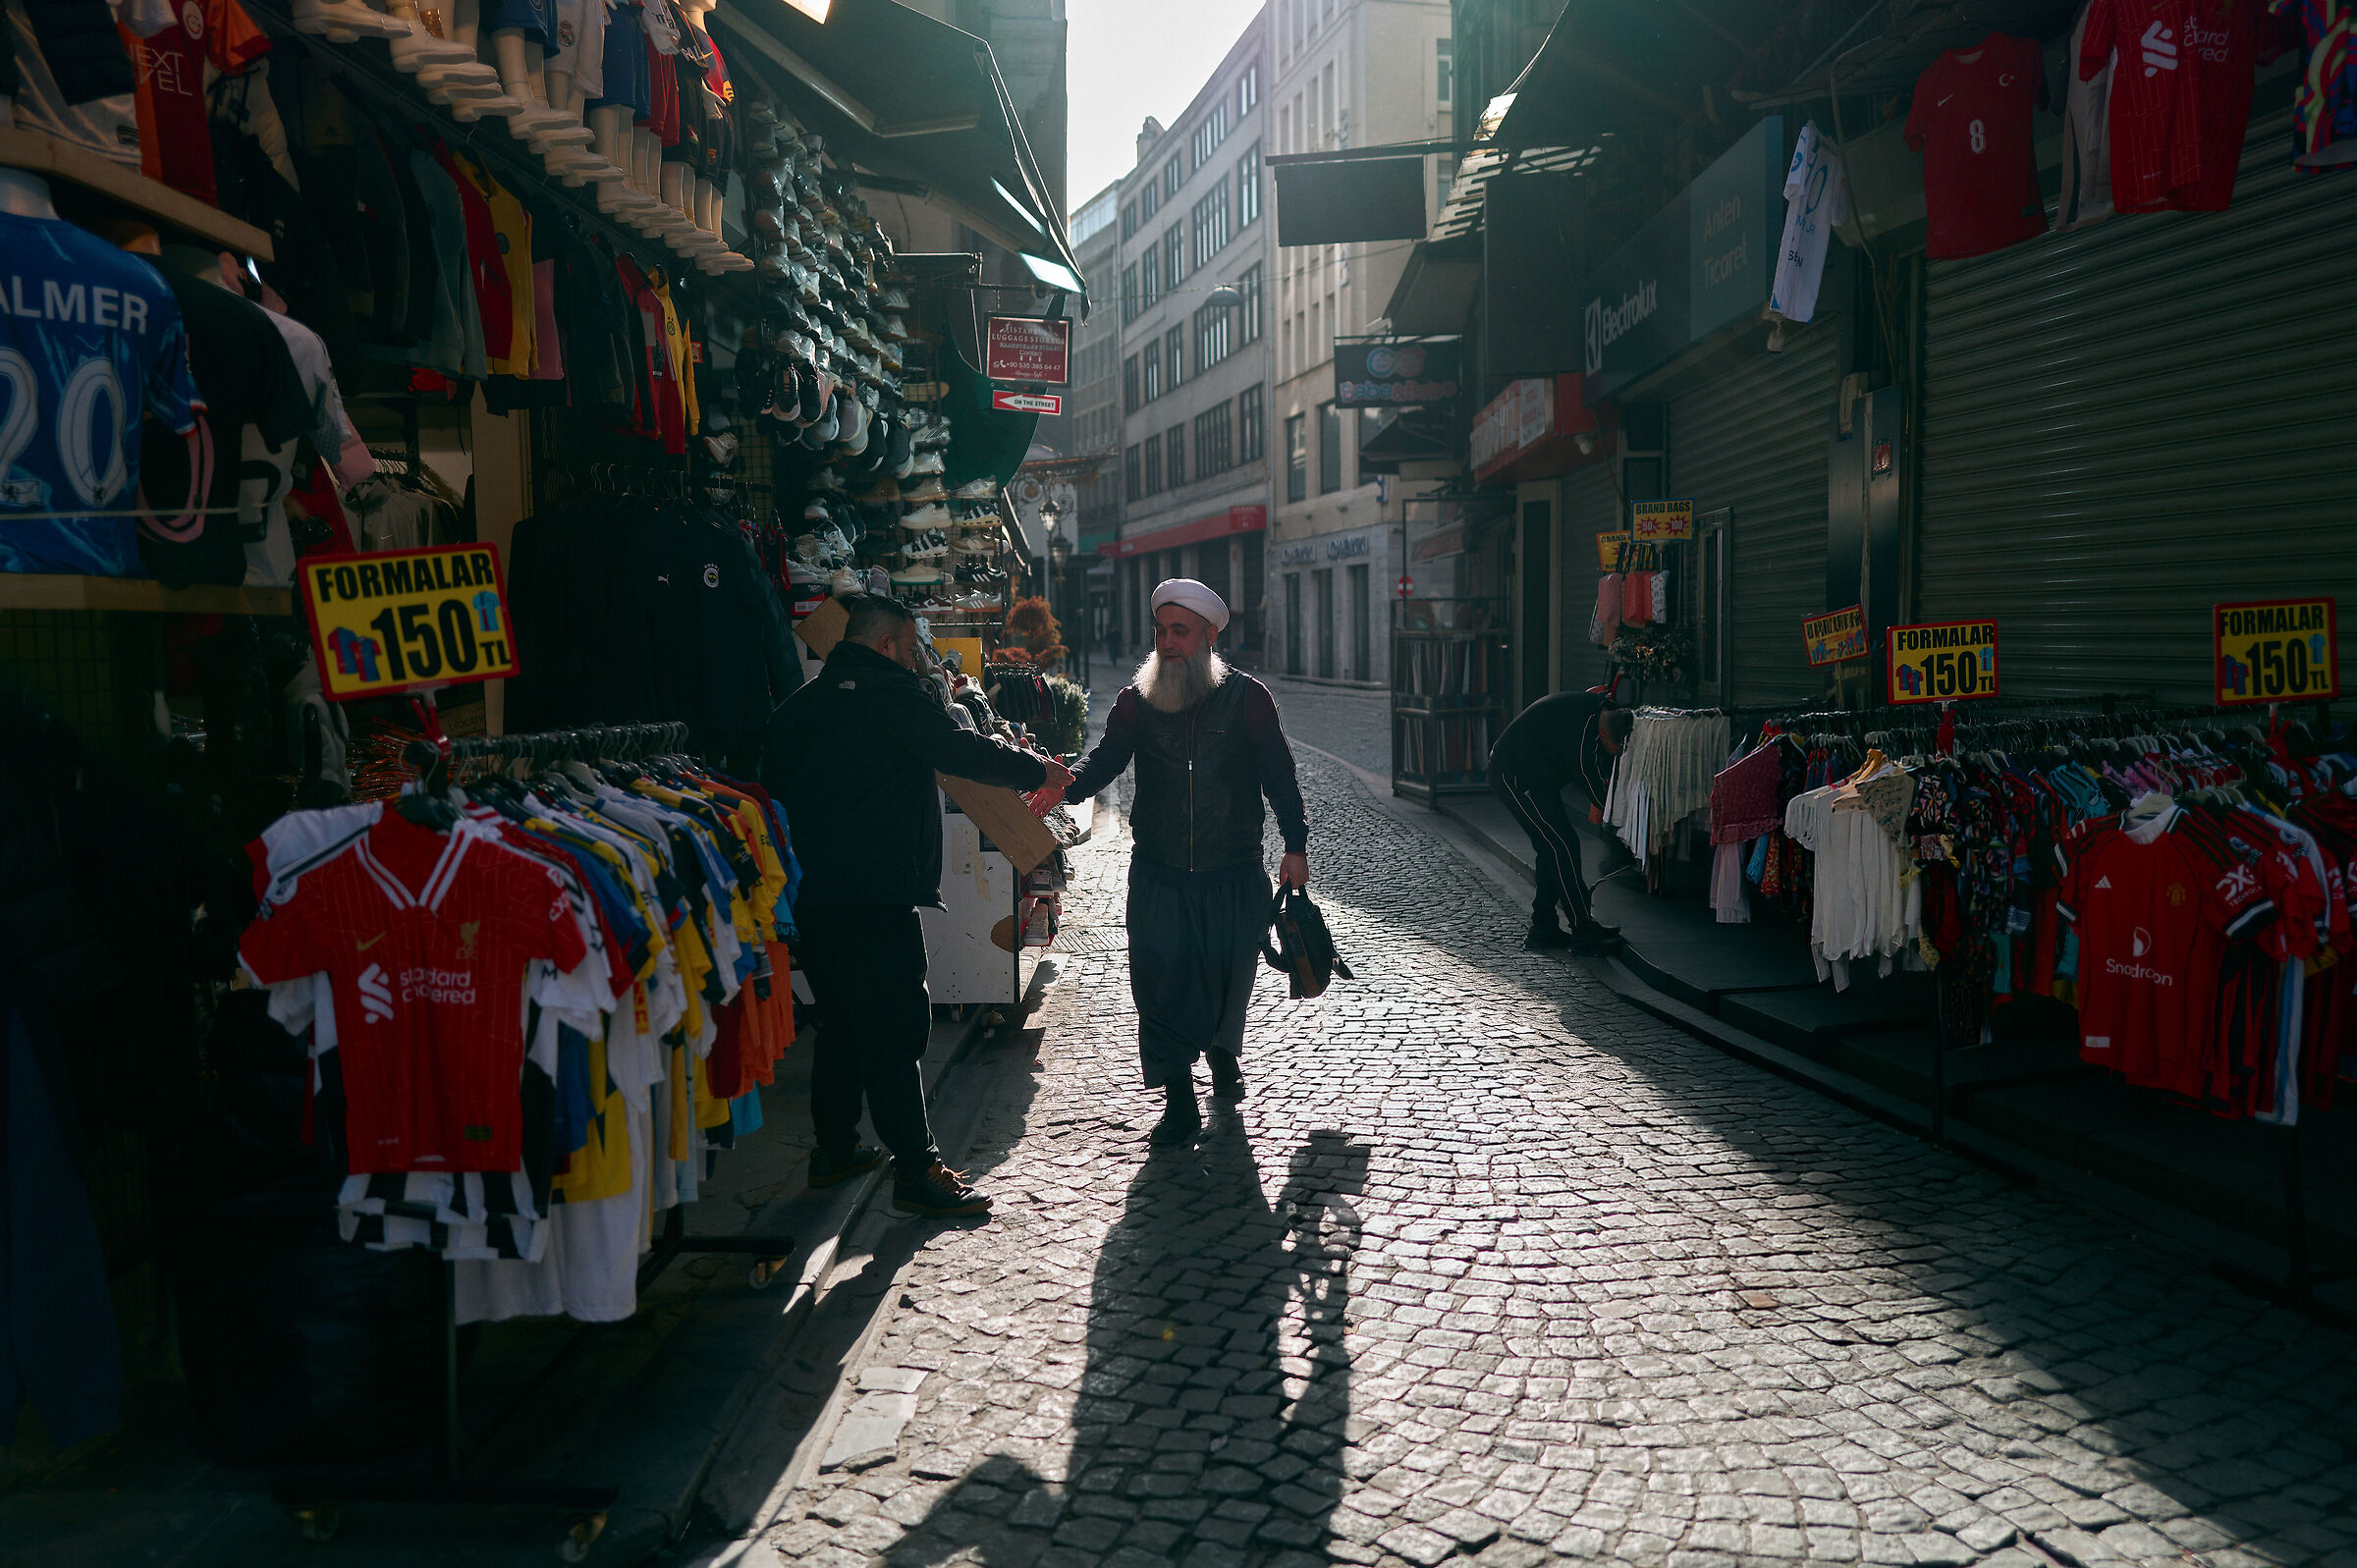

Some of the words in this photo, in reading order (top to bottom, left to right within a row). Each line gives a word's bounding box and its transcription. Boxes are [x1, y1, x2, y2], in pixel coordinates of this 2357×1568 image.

[1969, 119, 1986, 154] 8
[1703, 195, 1741, 243] Anten
[1703, 233, 1748, 291] Ticaret
[1603, 279, 1658, 347] Electrolux
[992, 333, 1028, 343] LUGGAGE
[1635, 503, 1666, 514] BRAND
[1668, 501, 1691, 513] BAGS
[316, 553, 494, 603] FORMALAR
[370, 599, 478, 681] 150
[480, 640, 512, 668] TL
[1897, 624, 1994, 651] FORMALAR
[2220, 605, 2324, 636] FORMALAR
[1921, 651, 1977, 696] 150
[2246, 638, 2307, 696] 150
[2310, 670, 2328, 690] TL
